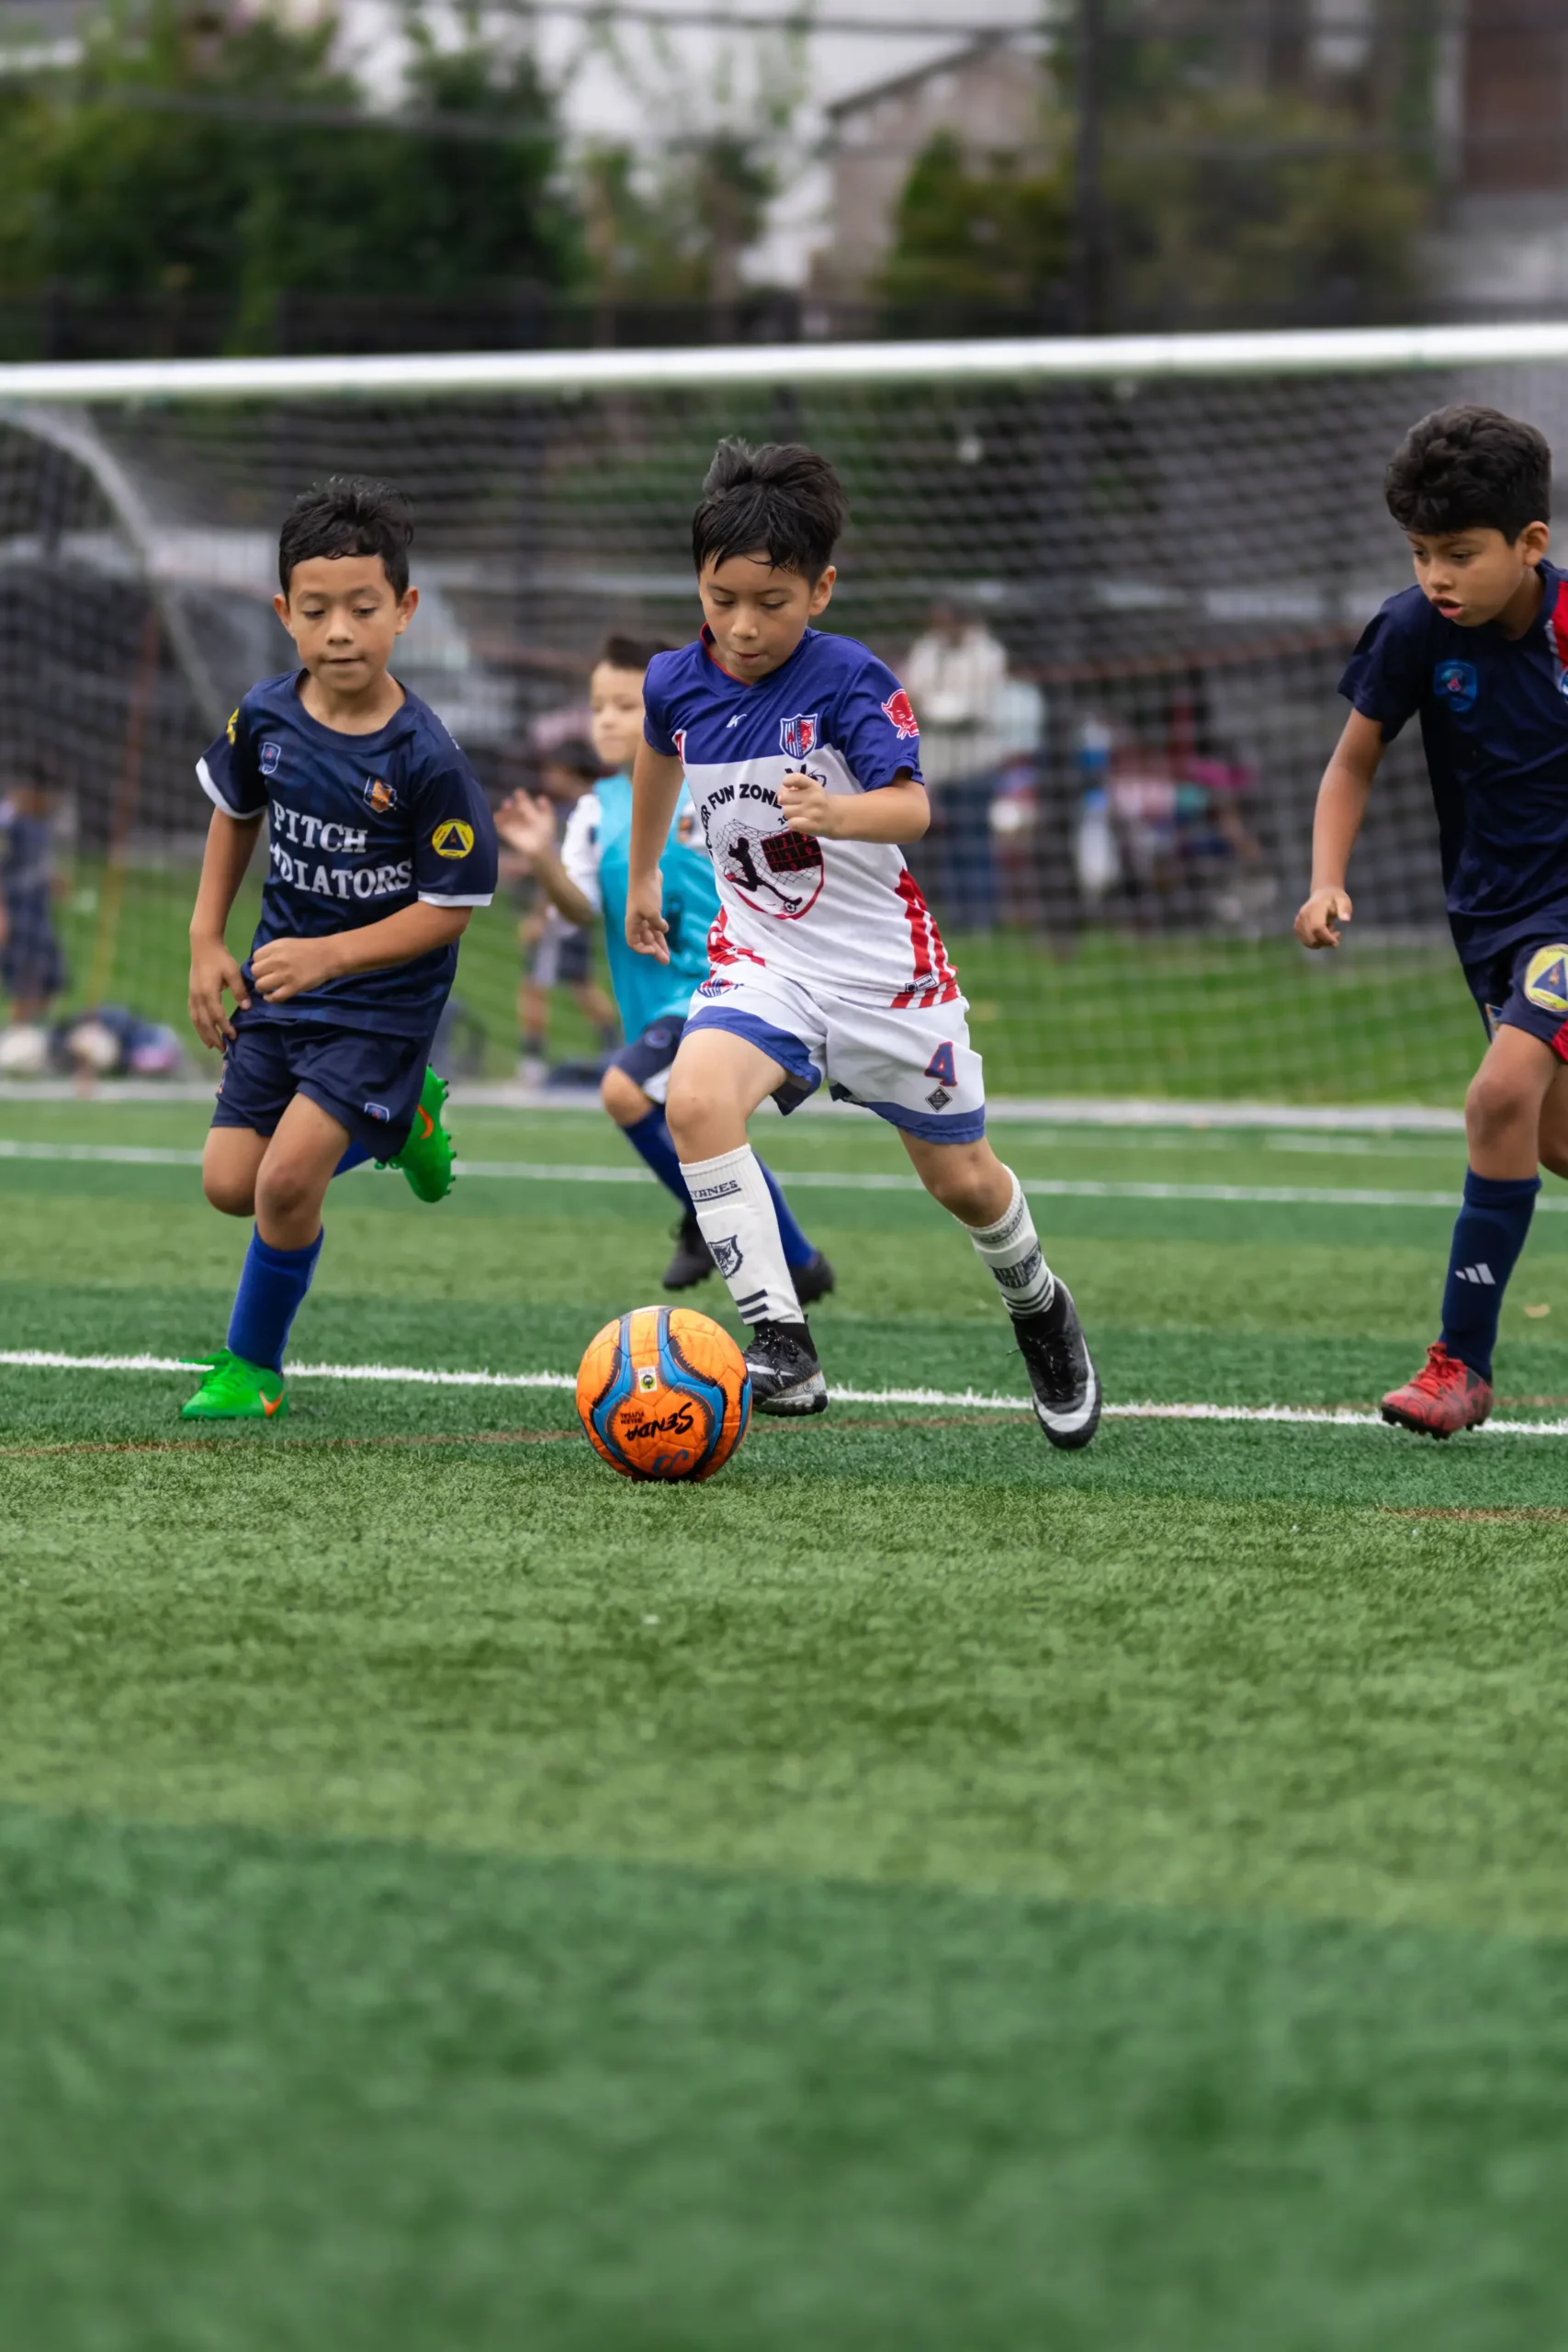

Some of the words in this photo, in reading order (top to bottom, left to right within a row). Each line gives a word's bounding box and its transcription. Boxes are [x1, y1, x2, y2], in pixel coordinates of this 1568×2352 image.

[707, 786, 735, 809] FUN
[272, 798, 368, 854] PITCH
[924, 1041, 958, 1087] 4
[625, 1402, 694, 1442] SENDA
